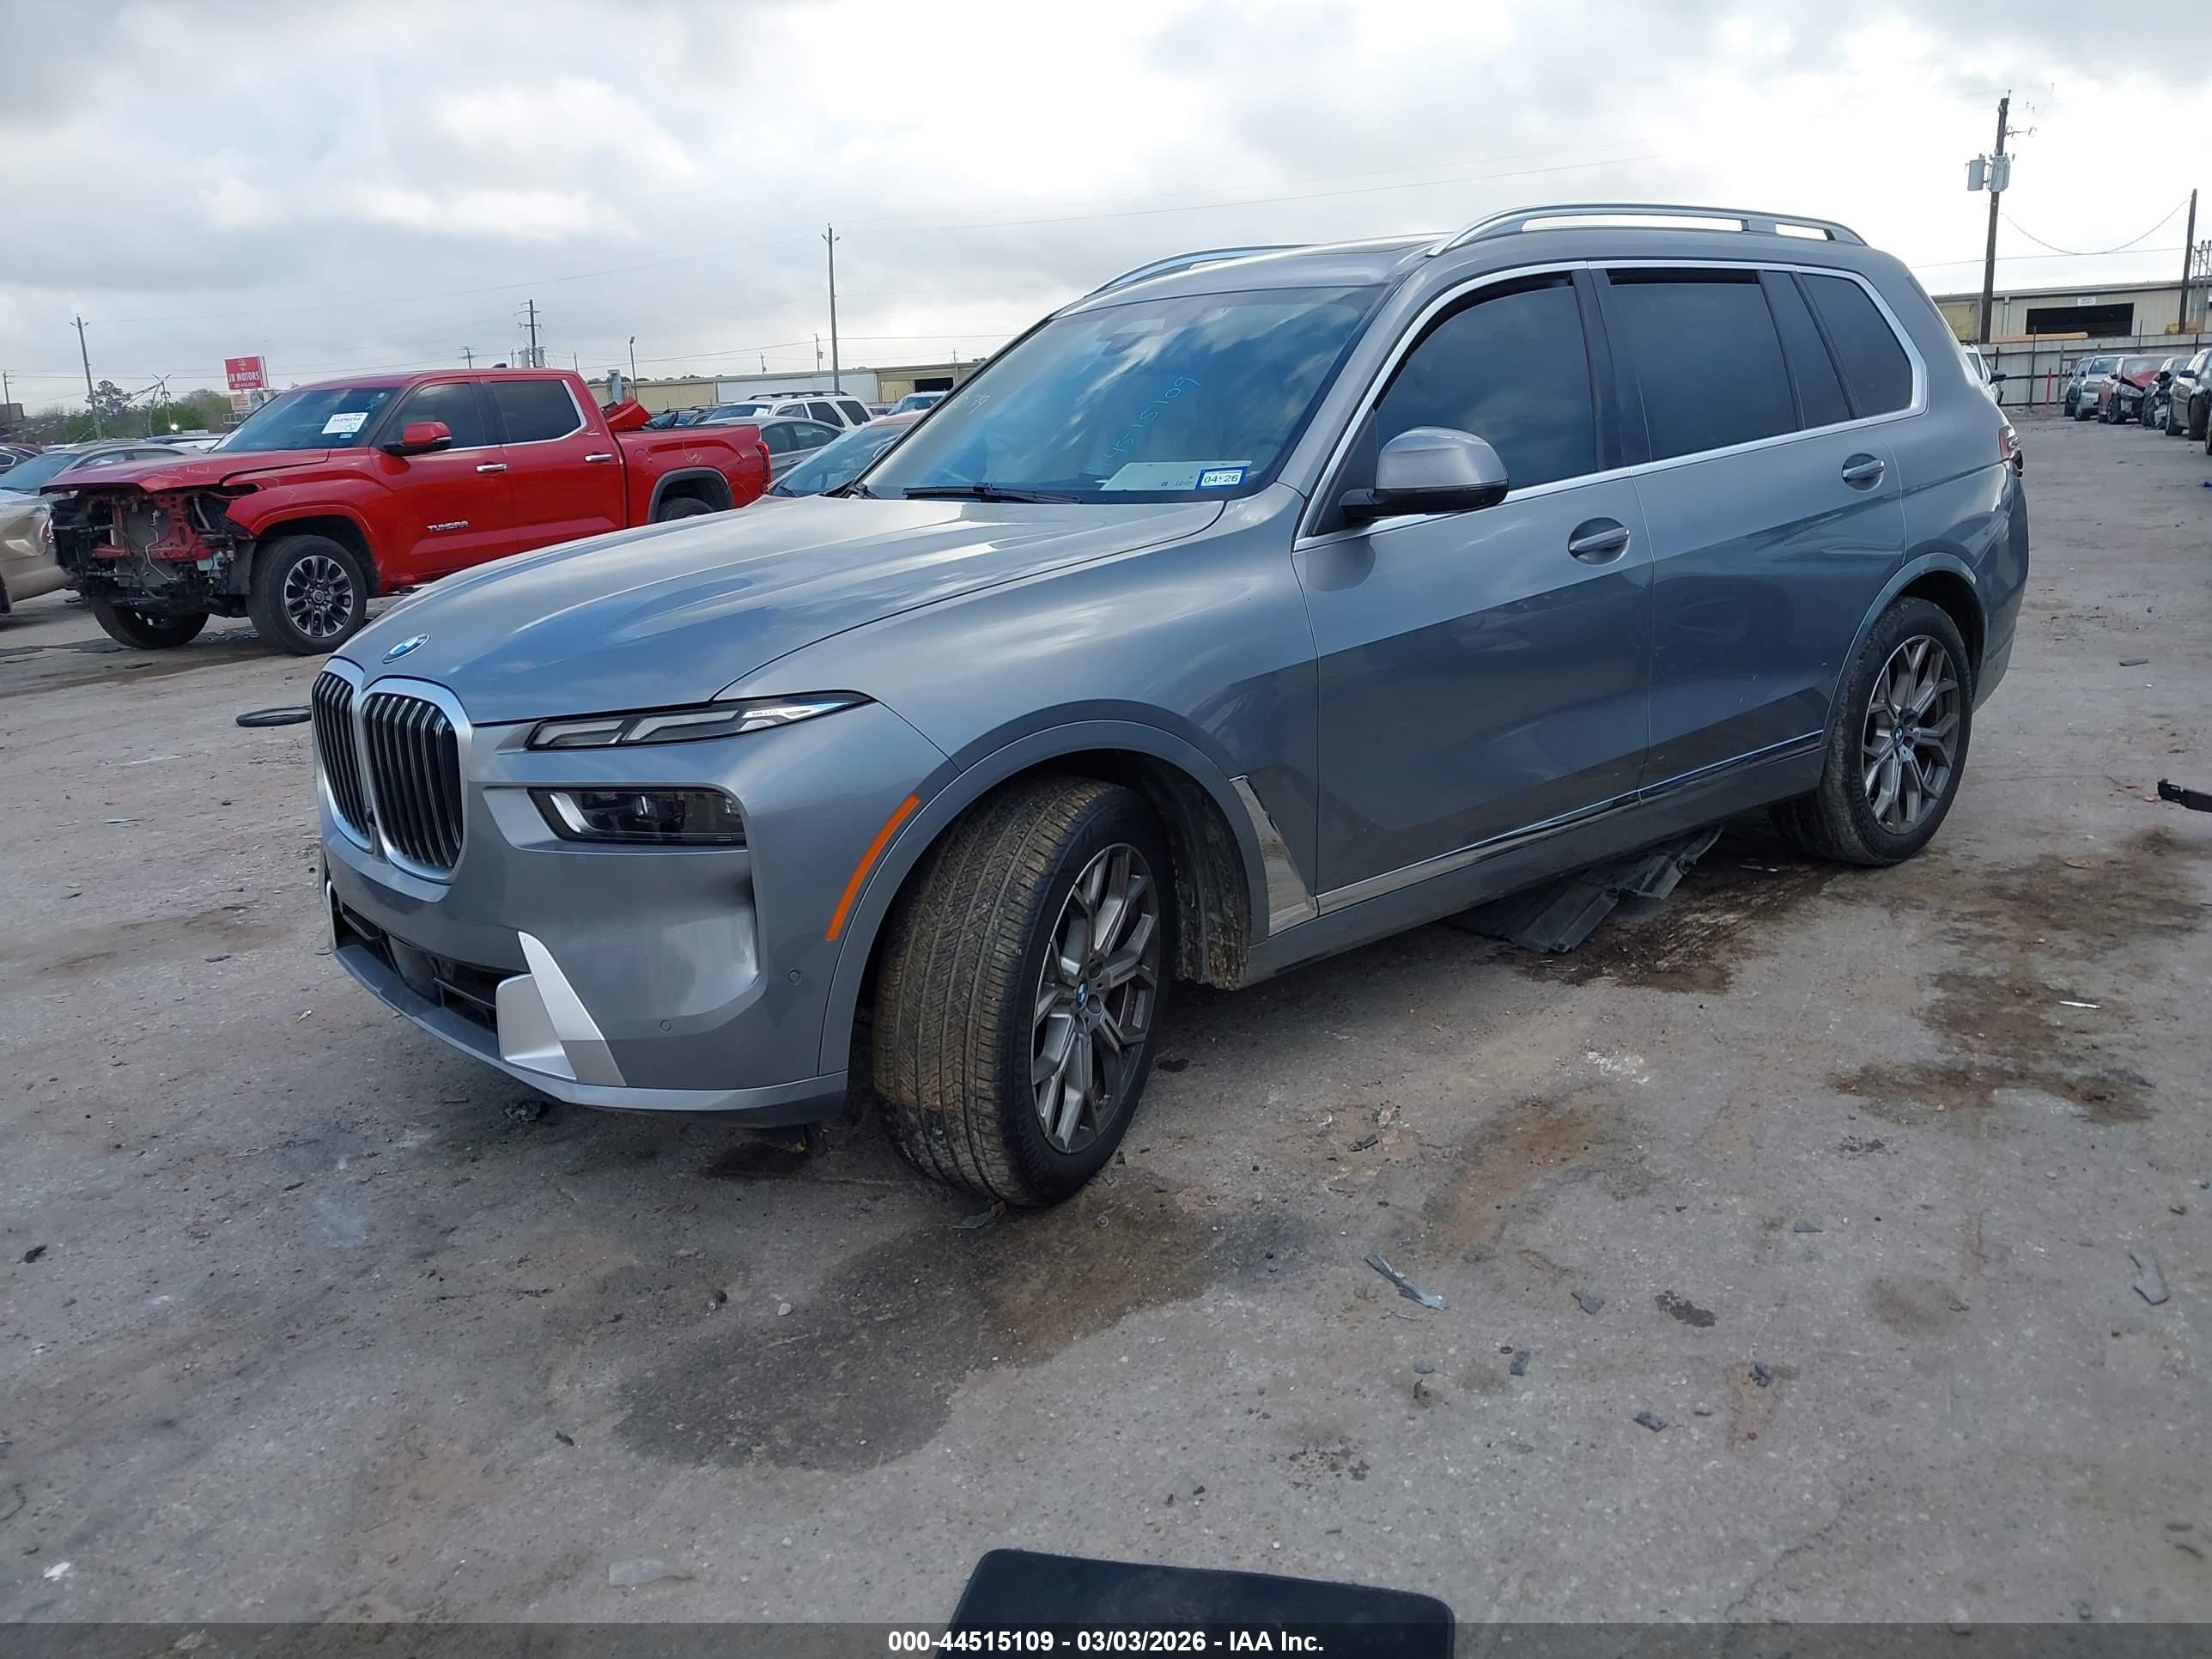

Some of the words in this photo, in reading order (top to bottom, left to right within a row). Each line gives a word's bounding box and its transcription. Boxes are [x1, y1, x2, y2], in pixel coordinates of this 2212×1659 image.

[228, 372, 236, 383] JB
[236, 371, 260, 382] MOTORS
[1203, 475, 1218, 483] 04
[1223, 474, 1239, 483] 26
[427, 520, 469, 532] TUNDRA
